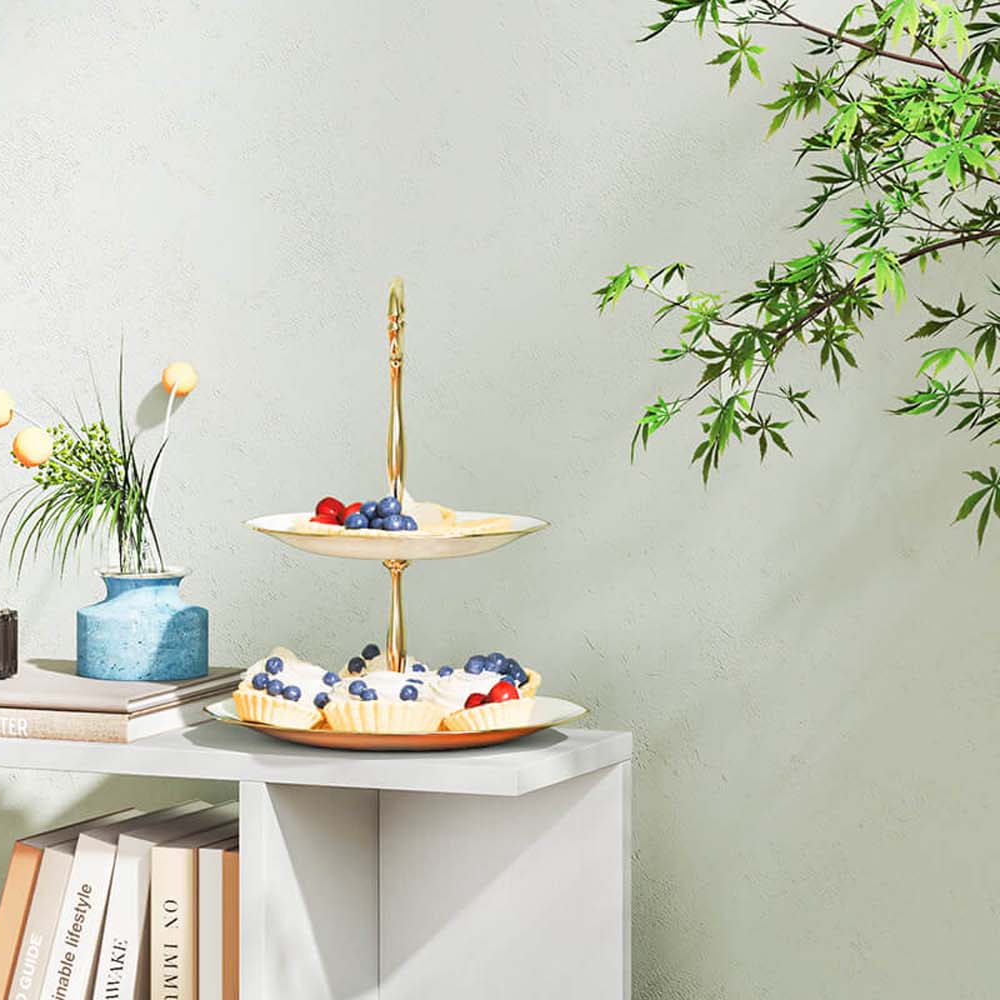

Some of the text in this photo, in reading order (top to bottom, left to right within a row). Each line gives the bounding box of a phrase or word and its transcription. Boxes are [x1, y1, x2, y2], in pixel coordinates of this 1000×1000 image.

[65, 883, 93, 949] lifestyle
[163, 899, 179, 929] ON
[20, 932, 44, 991] GUIDE
